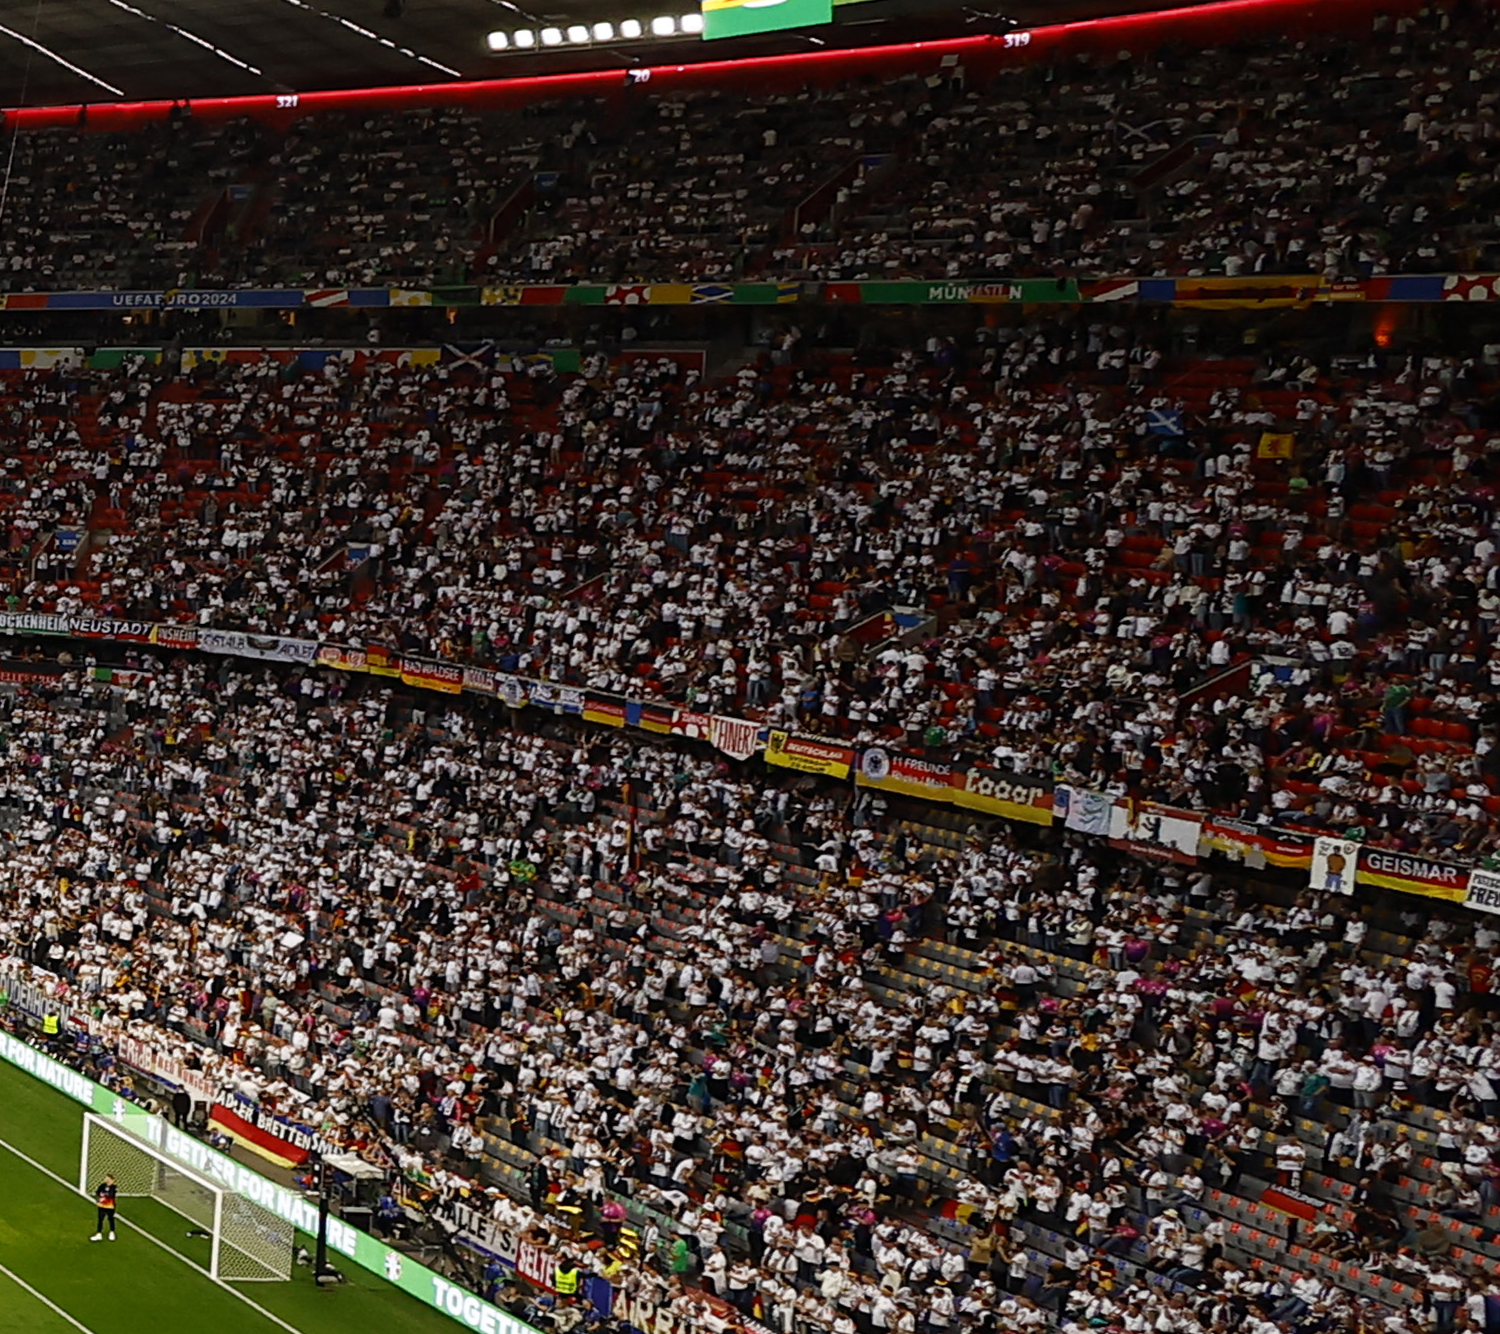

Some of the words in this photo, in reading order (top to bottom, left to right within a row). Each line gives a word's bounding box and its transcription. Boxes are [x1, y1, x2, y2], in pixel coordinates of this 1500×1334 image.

[1003, 32, 1031, 49] 319
[276, 96, 299, 109] 321
[928, 283, 1023, 300] MÜNN
[70, 617, 152, 636] NEUSTADT
[1367, 853, 1458, 884] GEISMAR
[7, 1037, 37, 1073] FOR
[35, 1053, 94, 1105] NATURE
[215, 1089, 254, 1122] ADLER
[256, 1111, 311, 1151] BRETTEN
[145, 1114, 237, 1189] TOGETHER
[235, 1167, 276, 1210] FOR
[276, 1187, 358, 1256] NATRE
